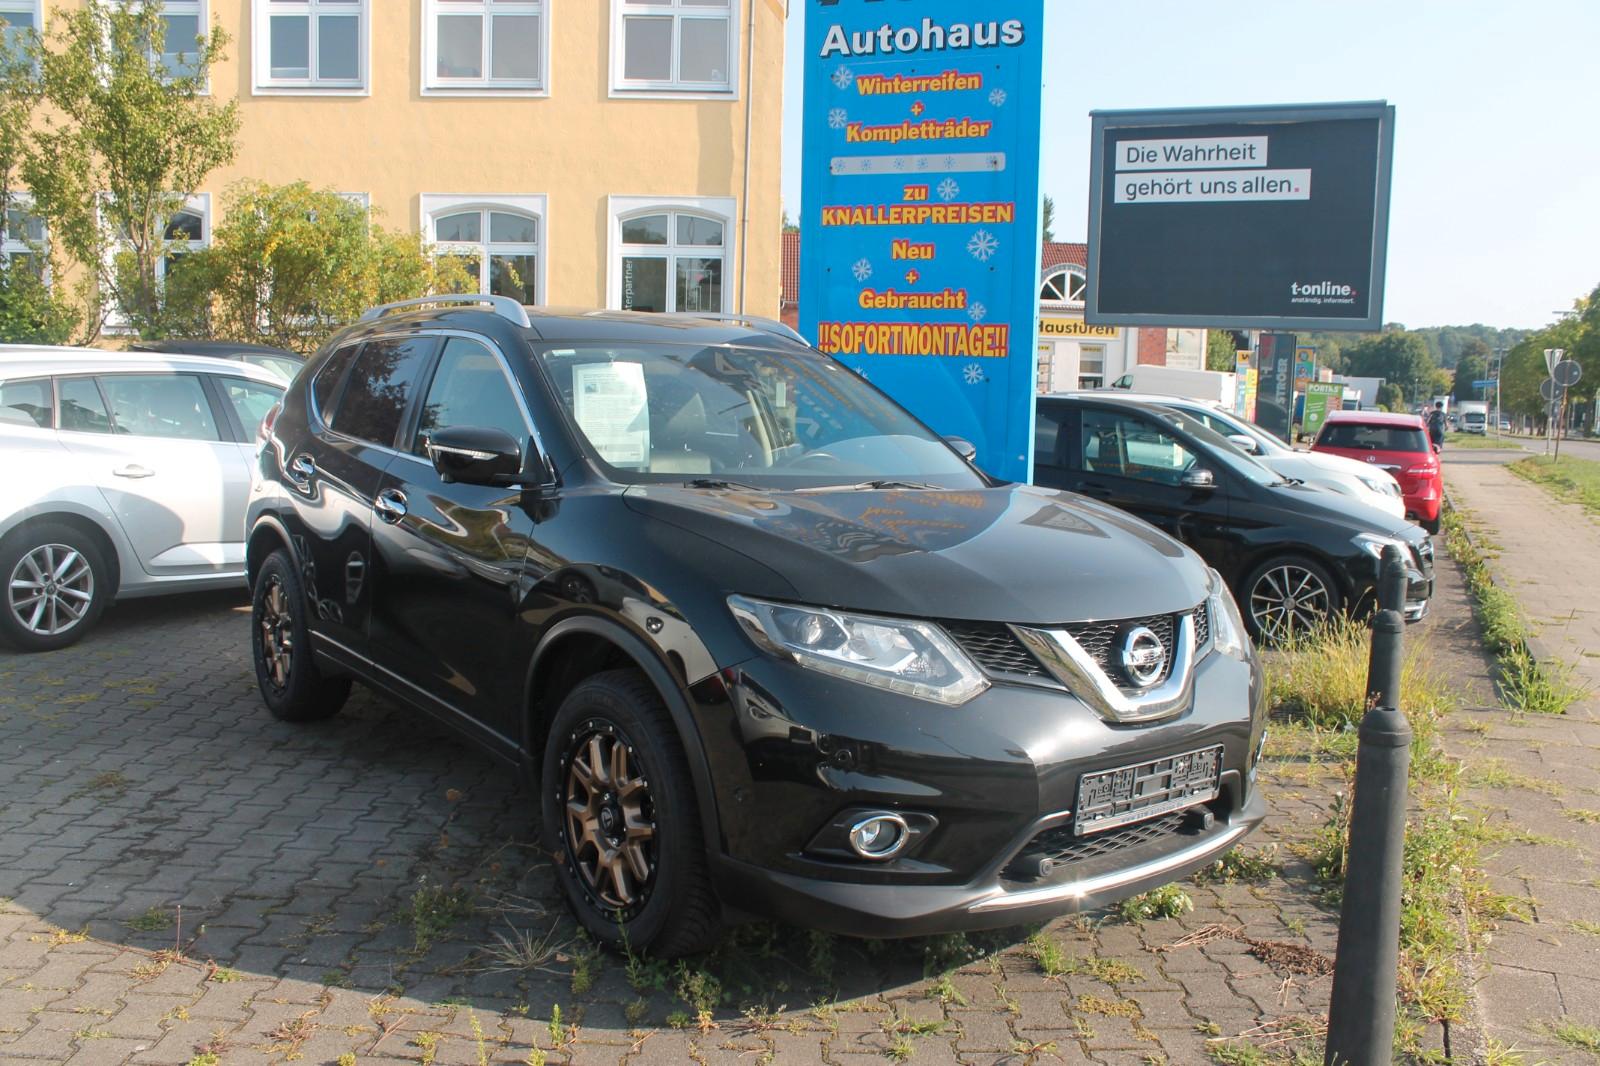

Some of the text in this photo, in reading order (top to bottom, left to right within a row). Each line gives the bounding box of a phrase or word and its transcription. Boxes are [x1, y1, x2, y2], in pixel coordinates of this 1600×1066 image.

[819, 17, 1025, 57] Autohaus
[856, 69, 982, 96] Winterreifen
[846, 118, 992, 144] Kompletträder
[1126, 143, 1256, 163] Die Wahrheit
[903, 184, 929, 201] zu
[1125, 175, 1300, 201] gehört uns allen.
[821, 203, 1014, 226] KNALLERPREISEN
[891, 239, 935, 261] Neu
[858, 288, 967, 310] Gebraucht
[1291, 281, 1357, 296] t-online.
[818, 321, 1009, 358] !!SOFORTMONTAGE!!
